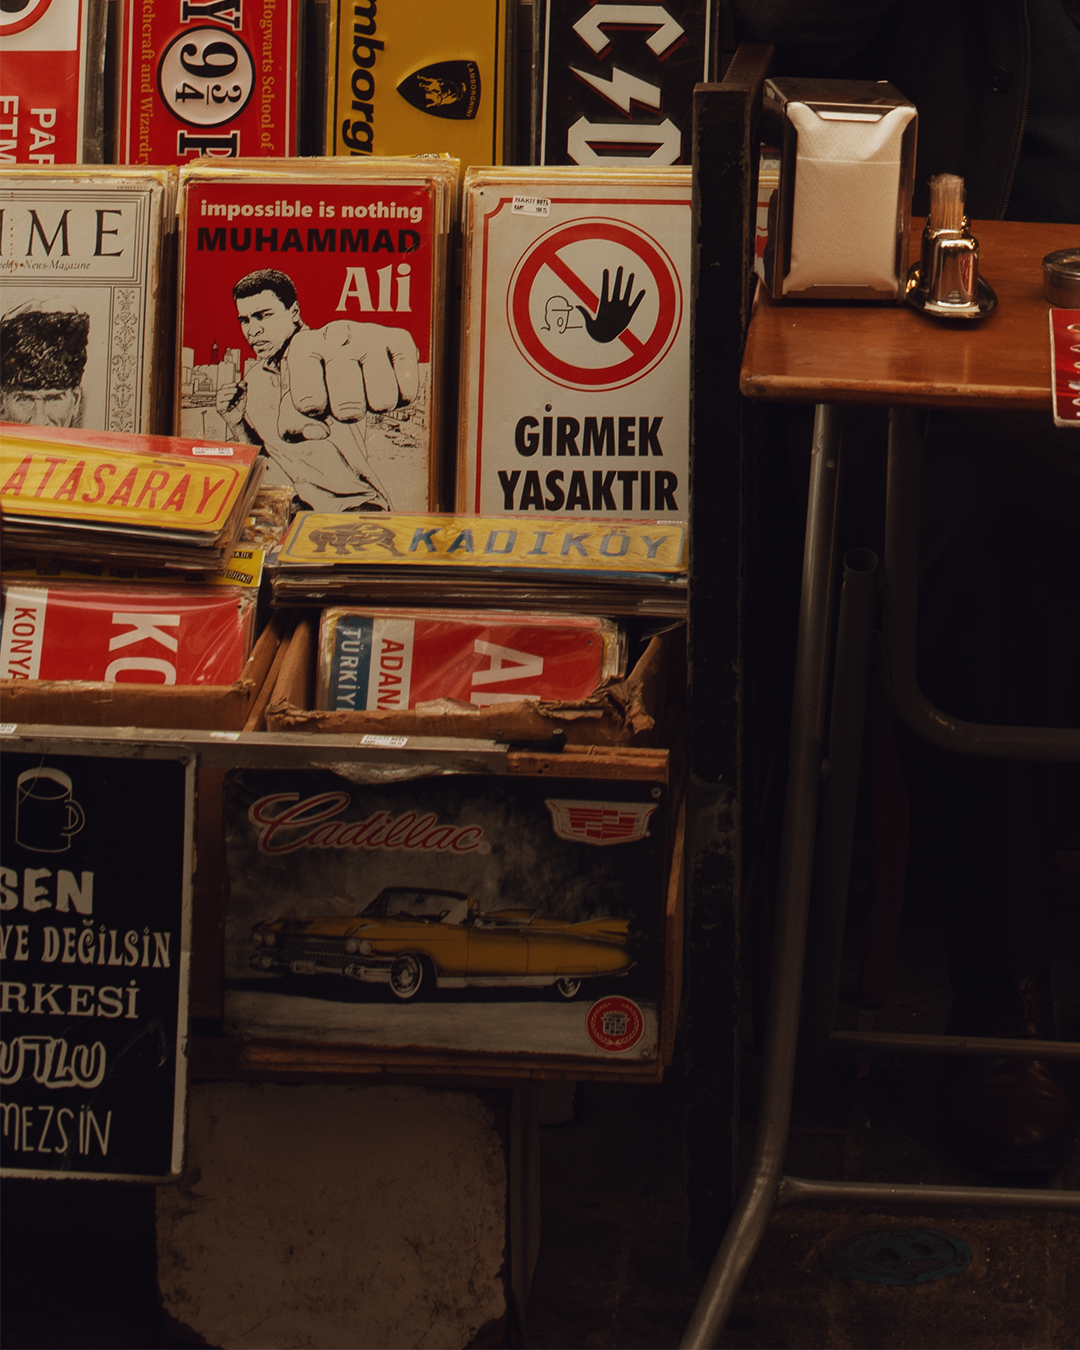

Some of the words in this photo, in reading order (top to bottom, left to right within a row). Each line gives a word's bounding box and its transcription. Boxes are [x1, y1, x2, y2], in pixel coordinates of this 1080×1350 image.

[140, 62, 154, 94] and
[261, 75, 276, 129] School
[260, 131, 276, 150] of
[201, 200, 313, 221] impossible
[319, 201, 335, 218] is
[341, 201, 423, 223] nothing
[197, 227, 421, 253] MUHAMMAD
[335, 263, 412, 312] Ali
[1, 453, 226, 514] ATASARAY
[498, 470, 679, 511] YASAKTIR
[408, 527, 671, 559] KADIKÖY
[228, 570, 255, 584] SIGNS
[470, 638, 545, 707] A
[248, 791, 484, 854] Cadillac
[43, 918, 172, 969] DEĞİLSİN
